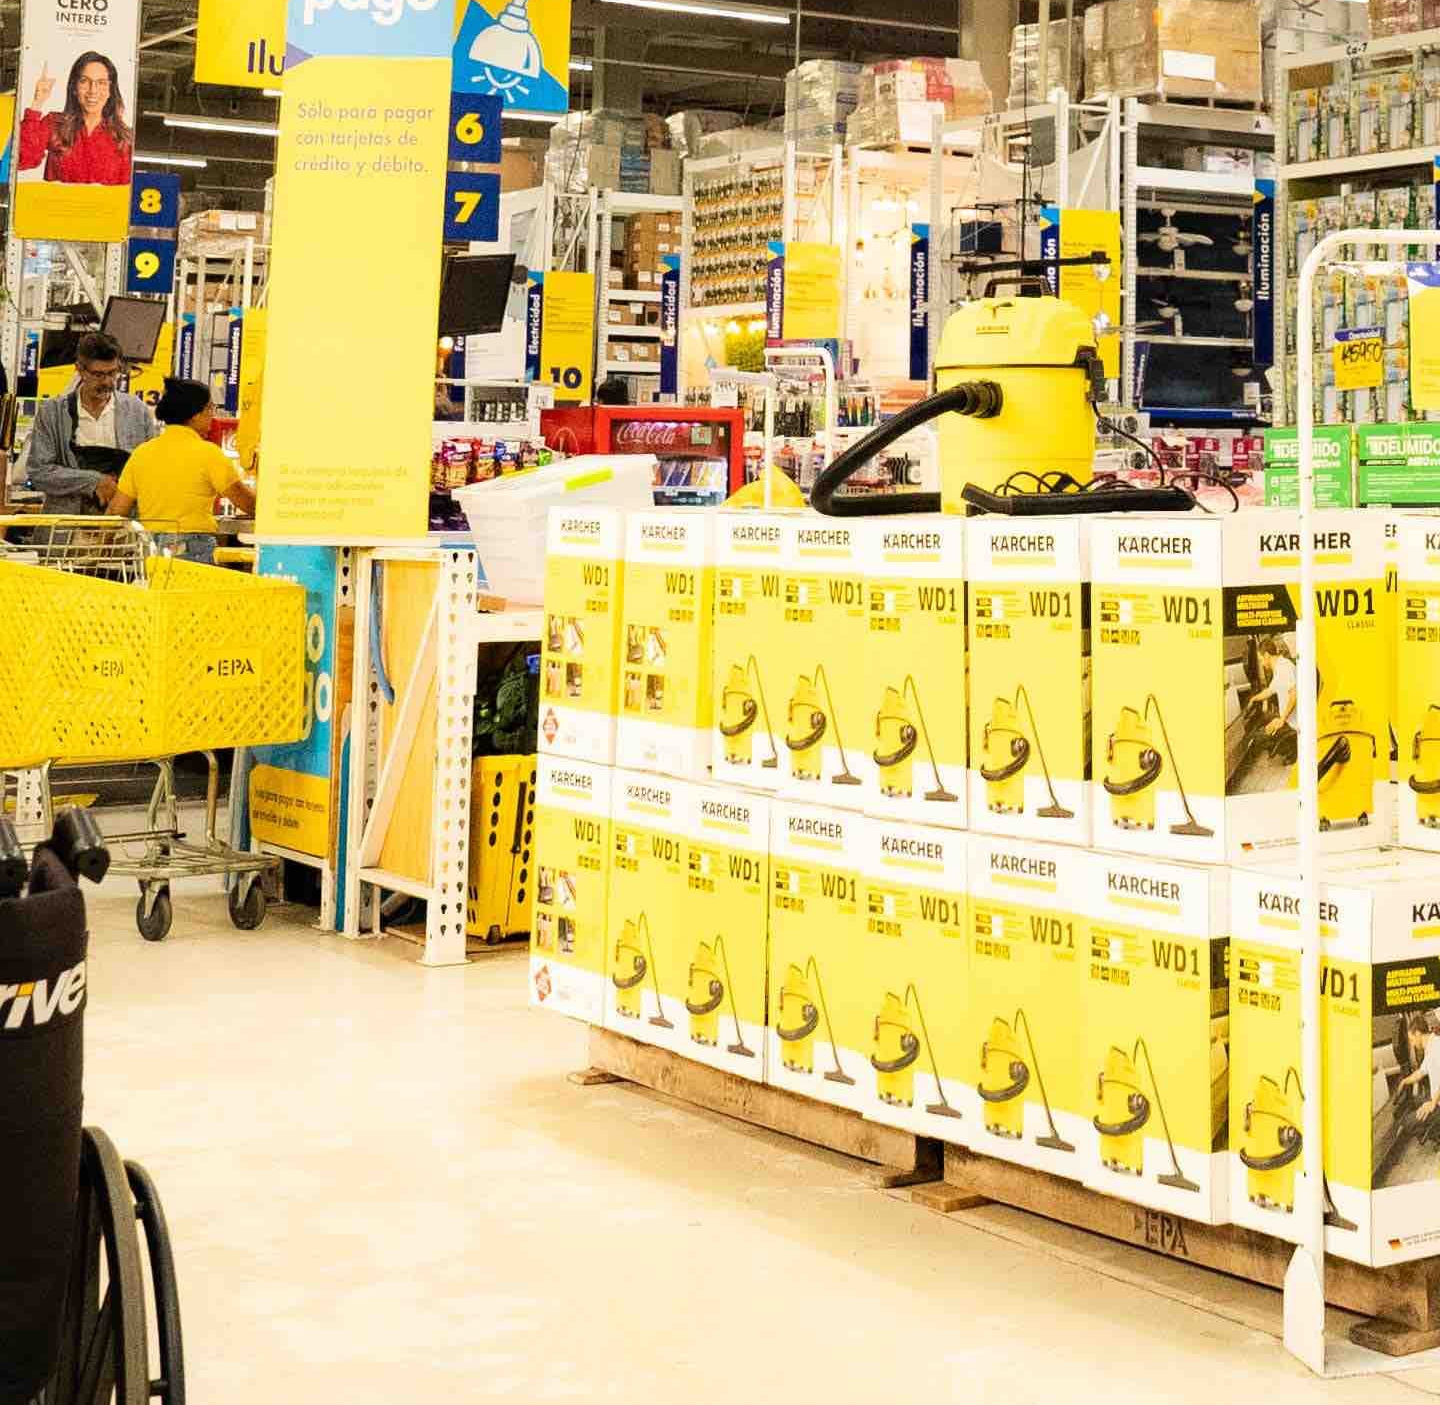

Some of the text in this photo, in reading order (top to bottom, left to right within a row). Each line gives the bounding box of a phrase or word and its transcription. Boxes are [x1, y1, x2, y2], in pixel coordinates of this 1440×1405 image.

[297, 103, 433, 124] Sólo para pagar
[295, 129, 417, 149] con tarjetas de
[455, 113, 484, 144] 6
[293, 153, 350, 174] crédito
[355, 158, 369, 176] y
[139, 189, 162, 214] 8
[454, 191, 482, 223] 7
[135, 252, 160, 278] 9
[1258, 212, 1270, 301] Iluminación
[768, 268, 782, 338] Iluminación
[528, 294, 540, 355] Electricidad
[550, 367, 582, 389] 10
[1259, 532, 1352, 552] KÄRHER
[583, 563, 609, 586] WD1
[665, 572, 695, 595] WD1
[829, 580, 864, 605] WD1
[918, 585, 957, 611] WD1
[1029, 592, 1073, 618] WD1
[1315, 588, 1376, 617] WD1
[1163, 595, 1213, 625] WD1
[217, 659, 255, 676] EPA
[574, 819, 602, 845] WD1
[651, 836, 681, 864] WD1
[729, 855, 761, 883] WD1
[821, 873, 858, 903] WD1
[919, 894, 961, 927] WD1
[1029, 914, 1075, 949] WD1
[1152, 940, 1201, 977] WD1
